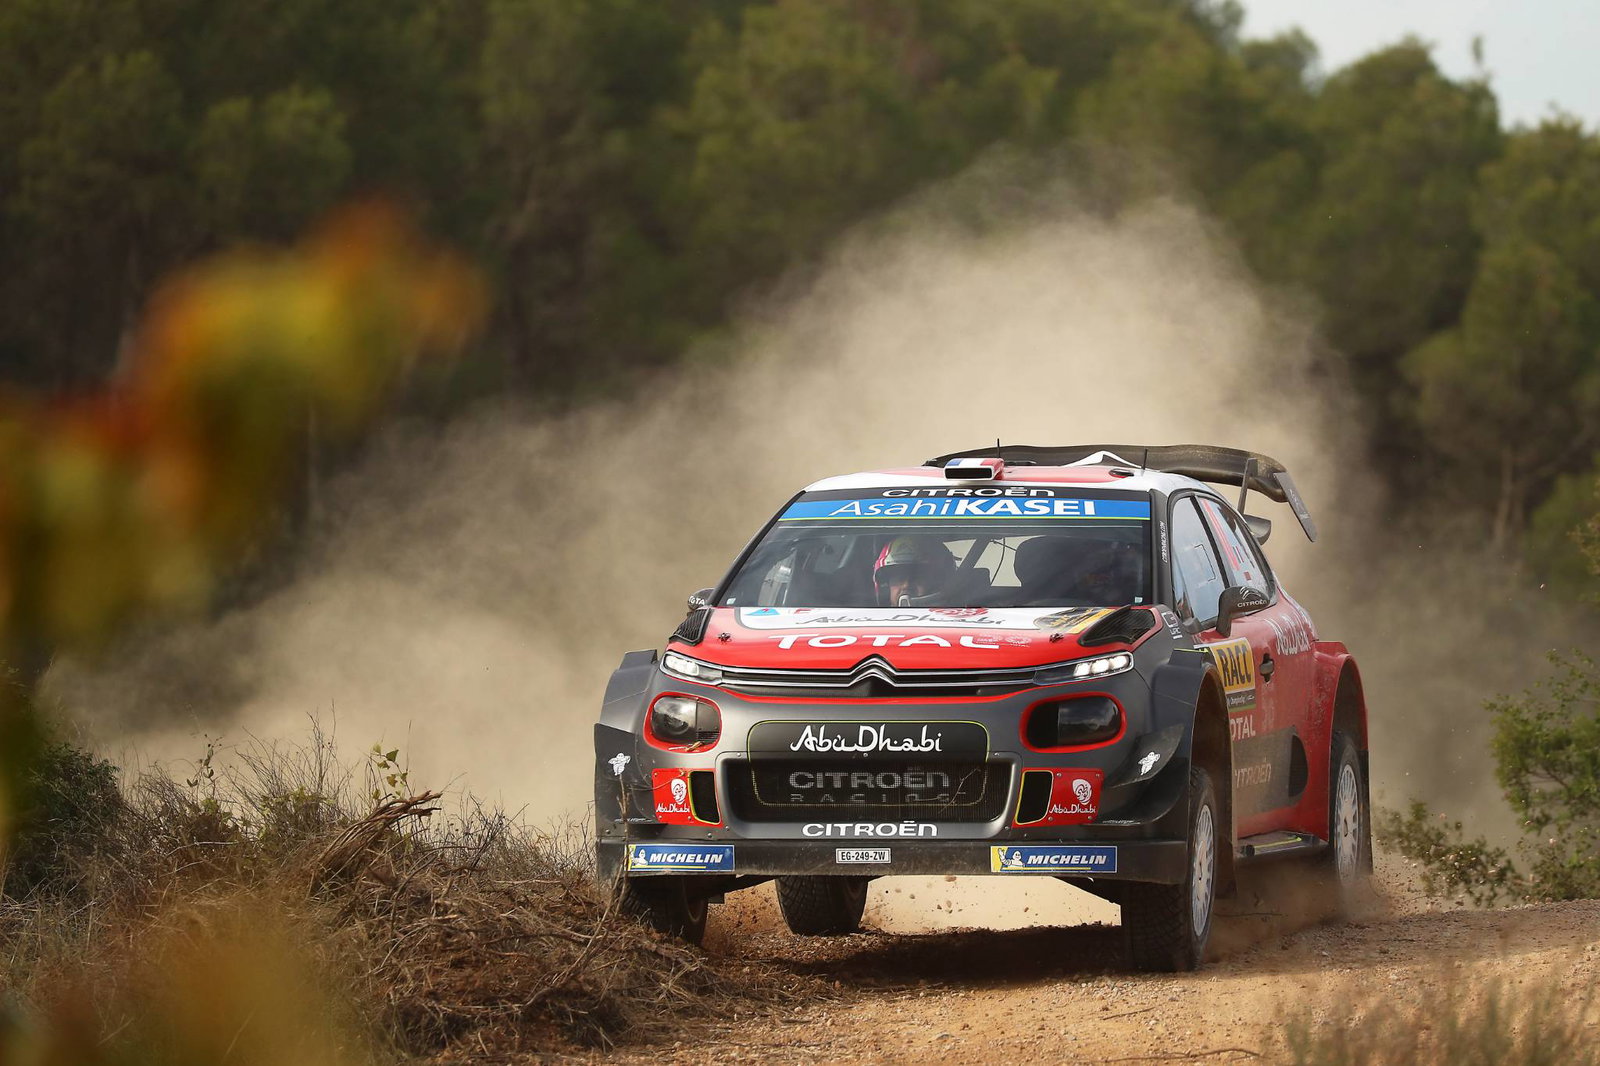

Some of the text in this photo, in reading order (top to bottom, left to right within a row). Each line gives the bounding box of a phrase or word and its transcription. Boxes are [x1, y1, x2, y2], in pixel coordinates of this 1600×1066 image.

[768, 634, 1000, 650] TOTAL
[1216, 645, 1252, 688] RACC
[1230, 714, 1257, 741] OTAL
[649, 853, 724, 864] MICHELIN
[840, 851, 887, 861] EG-249-ZW
[1027, 855, 1107, 865] MICHELIN
